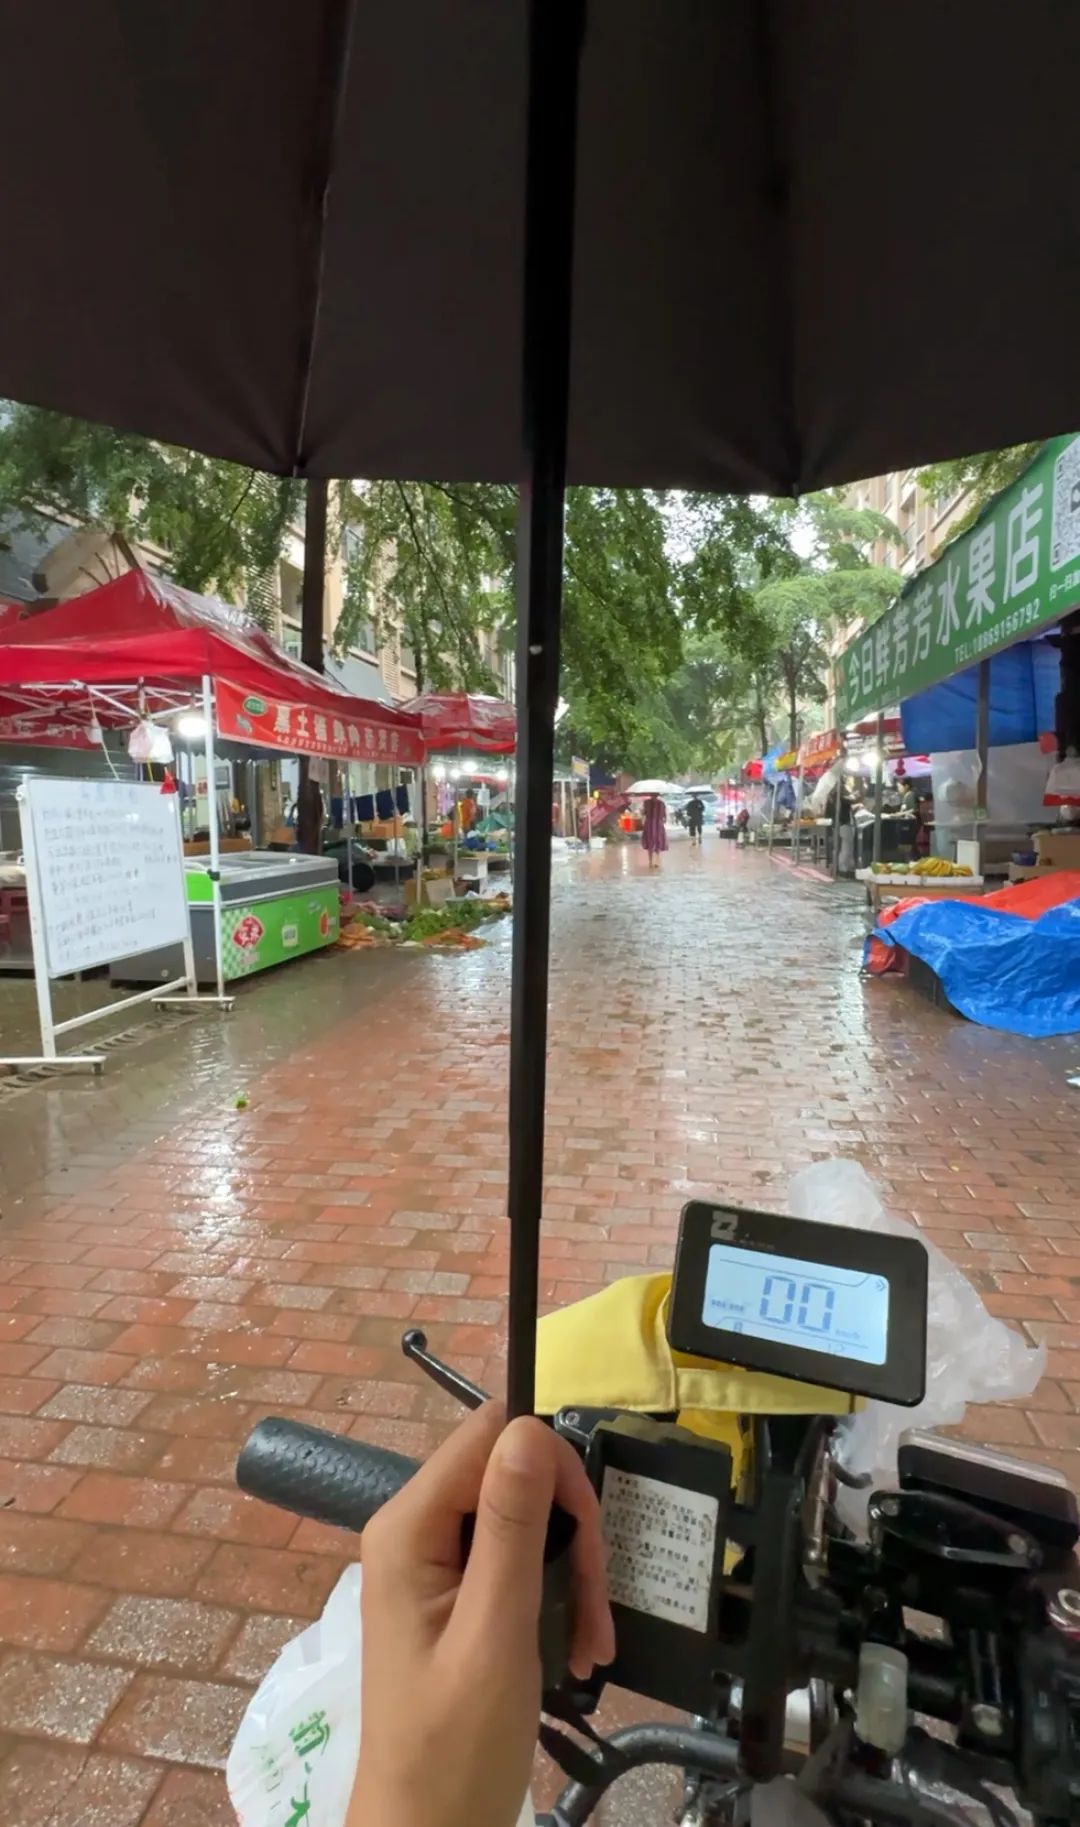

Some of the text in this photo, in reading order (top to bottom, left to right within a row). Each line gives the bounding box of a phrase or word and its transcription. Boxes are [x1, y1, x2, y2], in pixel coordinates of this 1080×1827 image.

[849, 483, 1043, 705] 今日鲜芳芳水果店
[760, 1275, 835, 1333] 00
